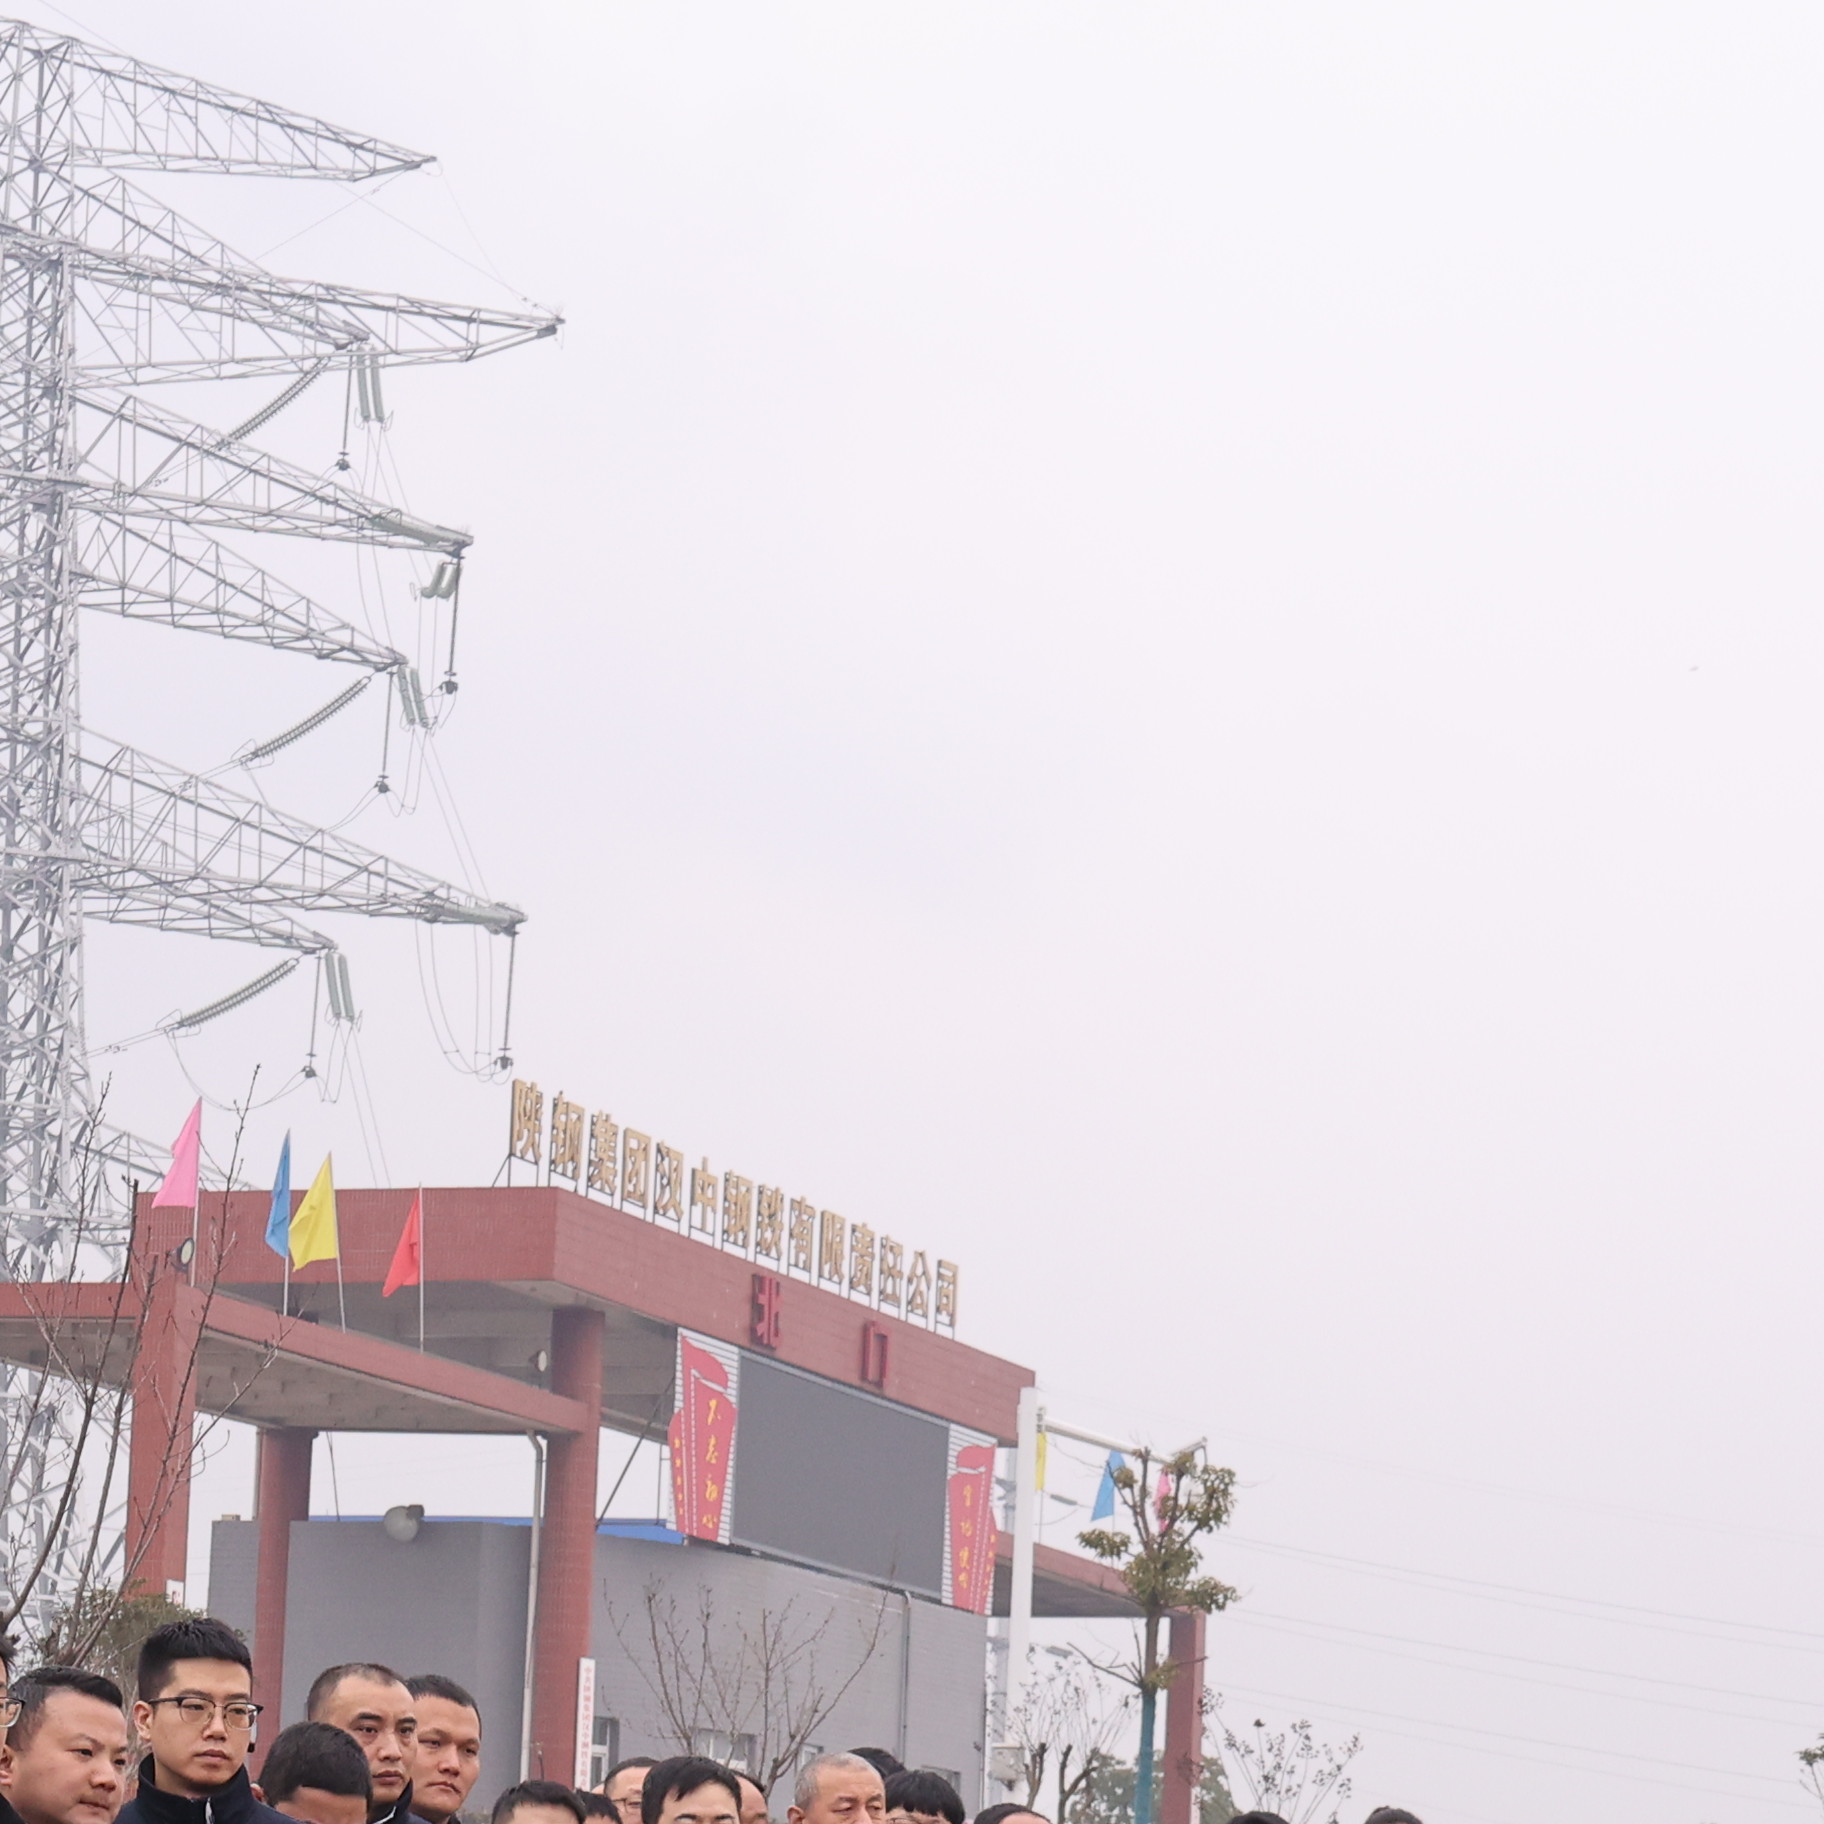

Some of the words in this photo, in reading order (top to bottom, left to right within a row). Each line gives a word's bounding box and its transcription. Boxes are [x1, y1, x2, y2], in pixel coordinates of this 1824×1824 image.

[510, 1078, 959, 1327] 陕钢集团汉中钢铁有限责任公司
[750, 1273, 891, 1387] 北门
